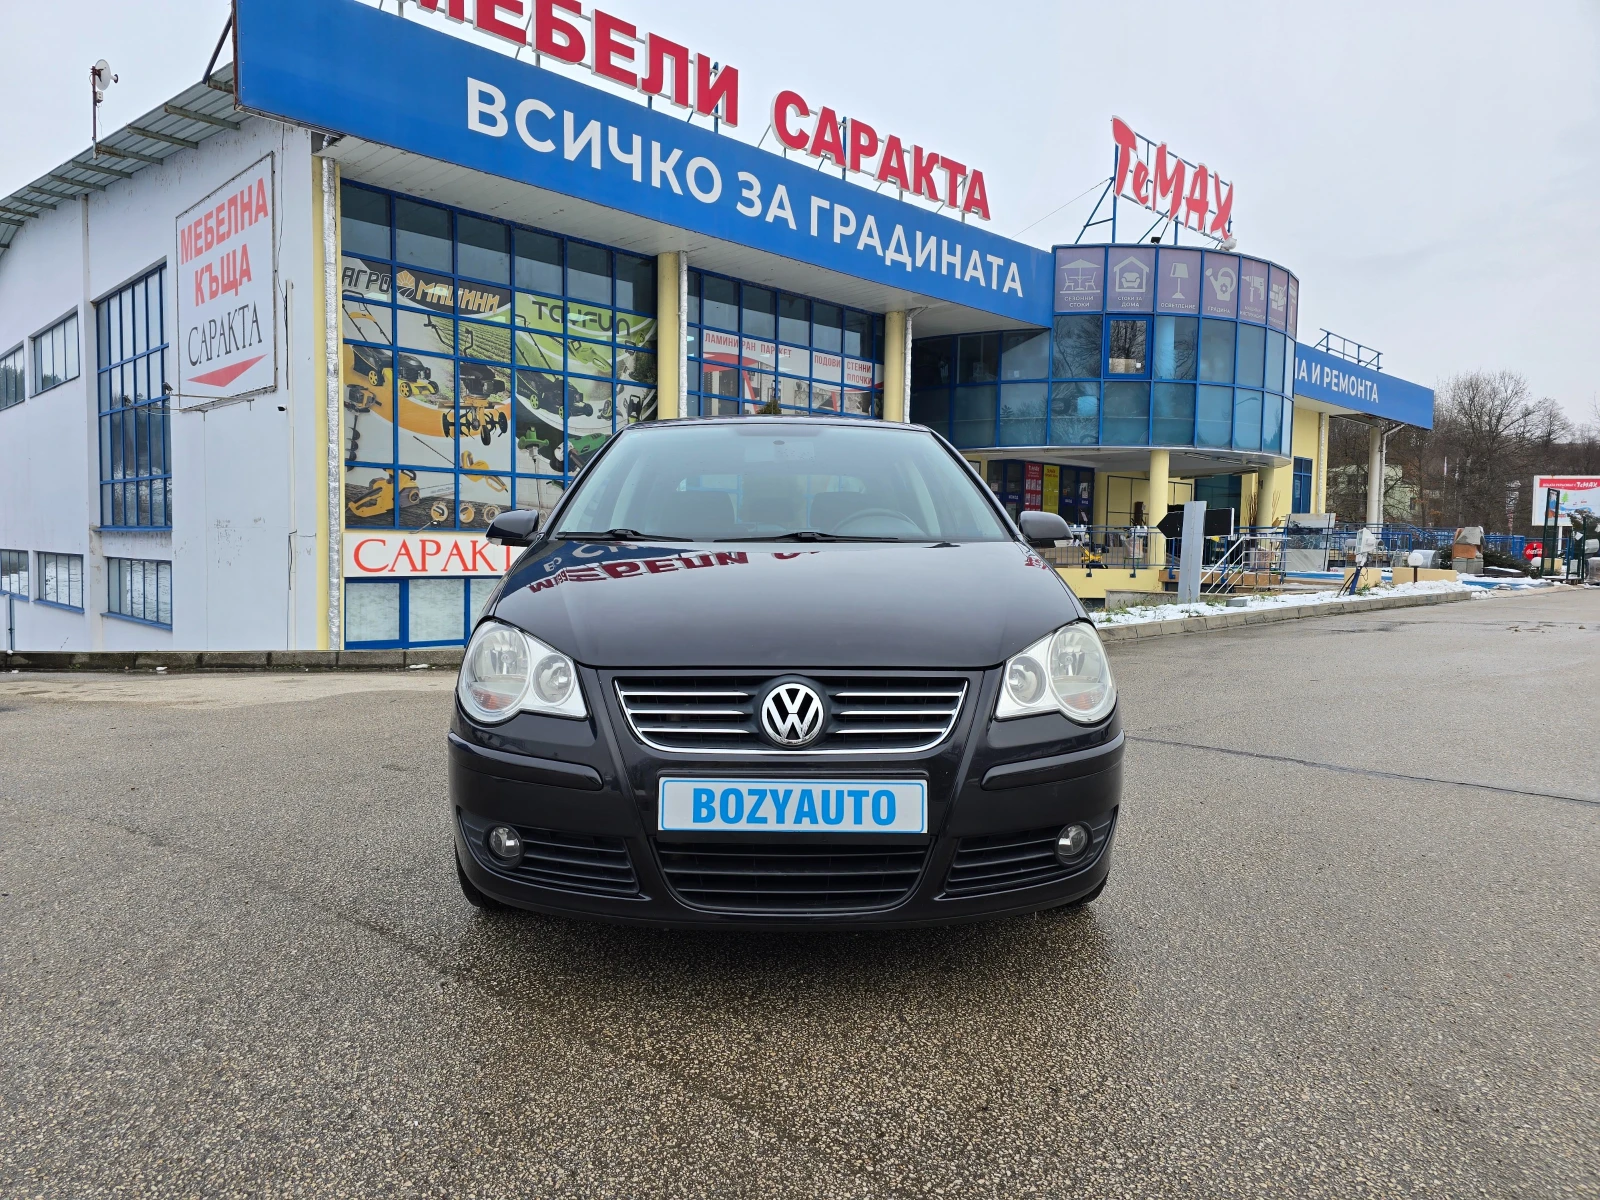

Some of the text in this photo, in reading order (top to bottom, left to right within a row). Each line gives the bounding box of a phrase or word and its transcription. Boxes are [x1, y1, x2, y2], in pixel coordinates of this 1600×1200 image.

[396, 0, 991, 221] ЕБЕЛИ САРАКТА
[467, 77, 1023, 297] ВСИЧКО ЗА ГРАДИНАТА
[1111, 115, 1233, 240] TeMAX
[180, 177, 268, 265] МЕБЕЛНА
[194, 243, 252, 307] КЪЩА
[342, 266, 500, 313] АГРО МАШИНИ
[188, 301, 262, 367] САРАКТА
[704, 332, 793, 359] ЛАМИНИРАН ПАРКЕТ
[814, 354, 872, 374] ПОДОВИ СТЕННИ
[846, 373, 873, 386] ПЛОЧКИ
[1311, 362, 1321, 385] И
[1323, 366, 1379, 404] РЕМОНТА
[692, 788, 897, 826] BOZYAUTO
